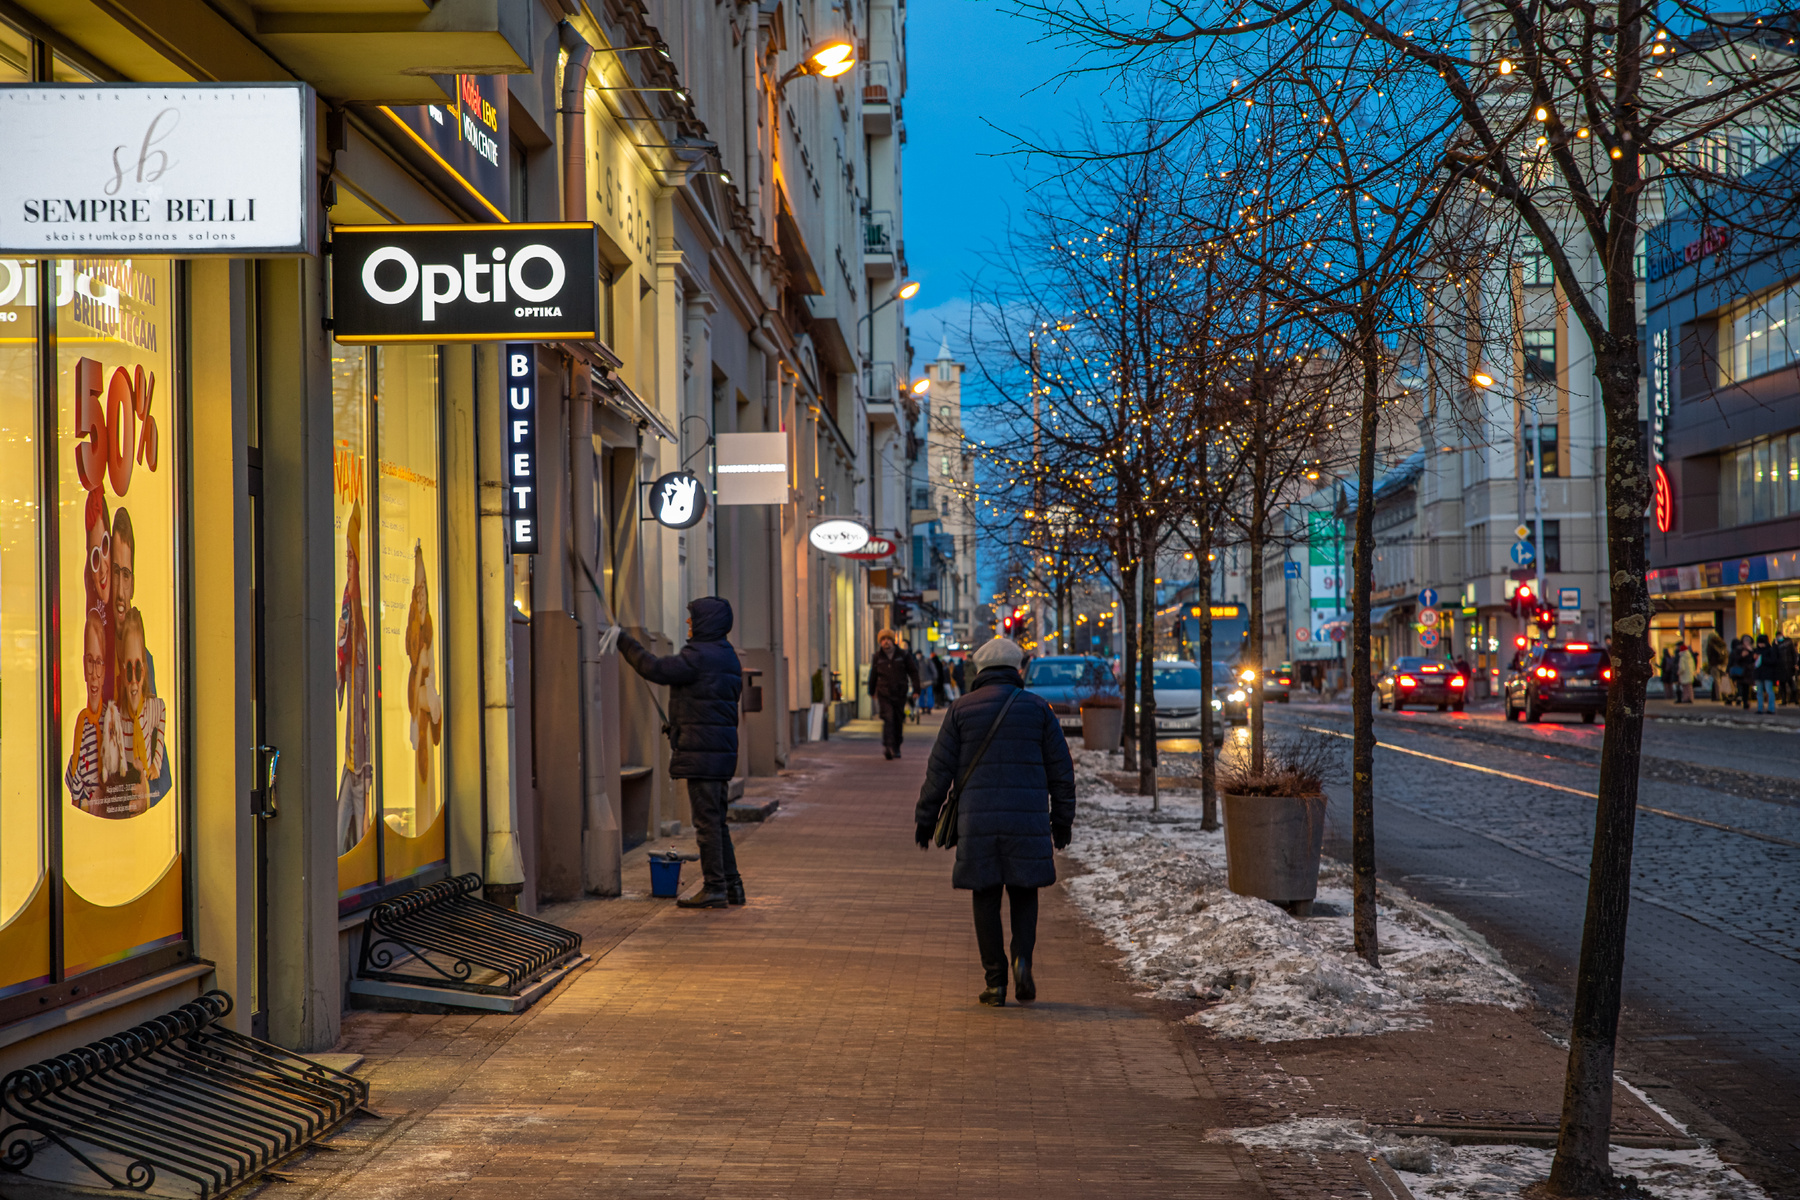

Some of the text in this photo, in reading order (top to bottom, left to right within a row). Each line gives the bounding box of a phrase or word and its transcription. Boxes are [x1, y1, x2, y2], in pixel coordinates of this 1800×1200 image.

[461, 74, 498, 133] Kodak LENS
[462, 112, 479, 152] VISION
[478, 130, 499, 168] CENTRE
[23, 198, 257, 223] SEMPRE BELLI
[45, 230, 237, 243] skaistumkopšanas salons
[135, 270, 157, 307] VAI
[361, 244, 566, 321] OptiO
[514, 306, 562, 318] OPTIKA
[75, 356, 159, 498] 50%
[510, 354, 532, 543] BUFETE
[1653, 331, 1674, 533] my fitness
